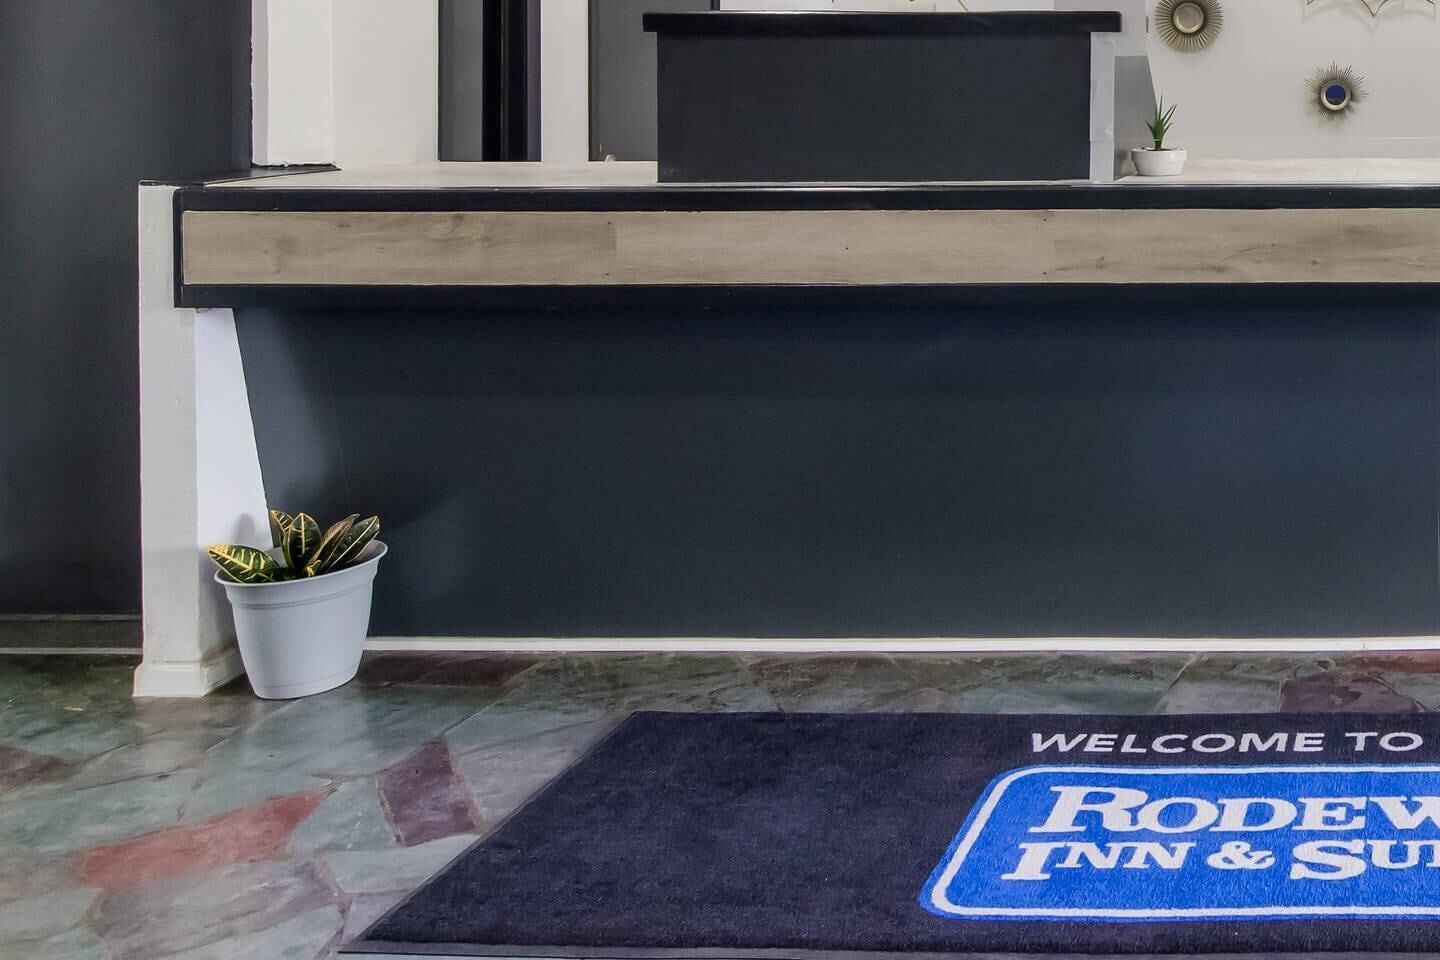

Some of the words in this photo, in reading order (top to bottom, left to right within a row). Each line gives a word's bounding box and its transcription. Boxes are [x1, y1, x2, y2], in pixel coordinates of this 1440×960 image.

[1031, 731, 1326, 754] WELCOME
[1343, 730, 1425, 753] TO
[1000, 840, 1197, 882] INN
[1206, 839, 1276, 871] &
